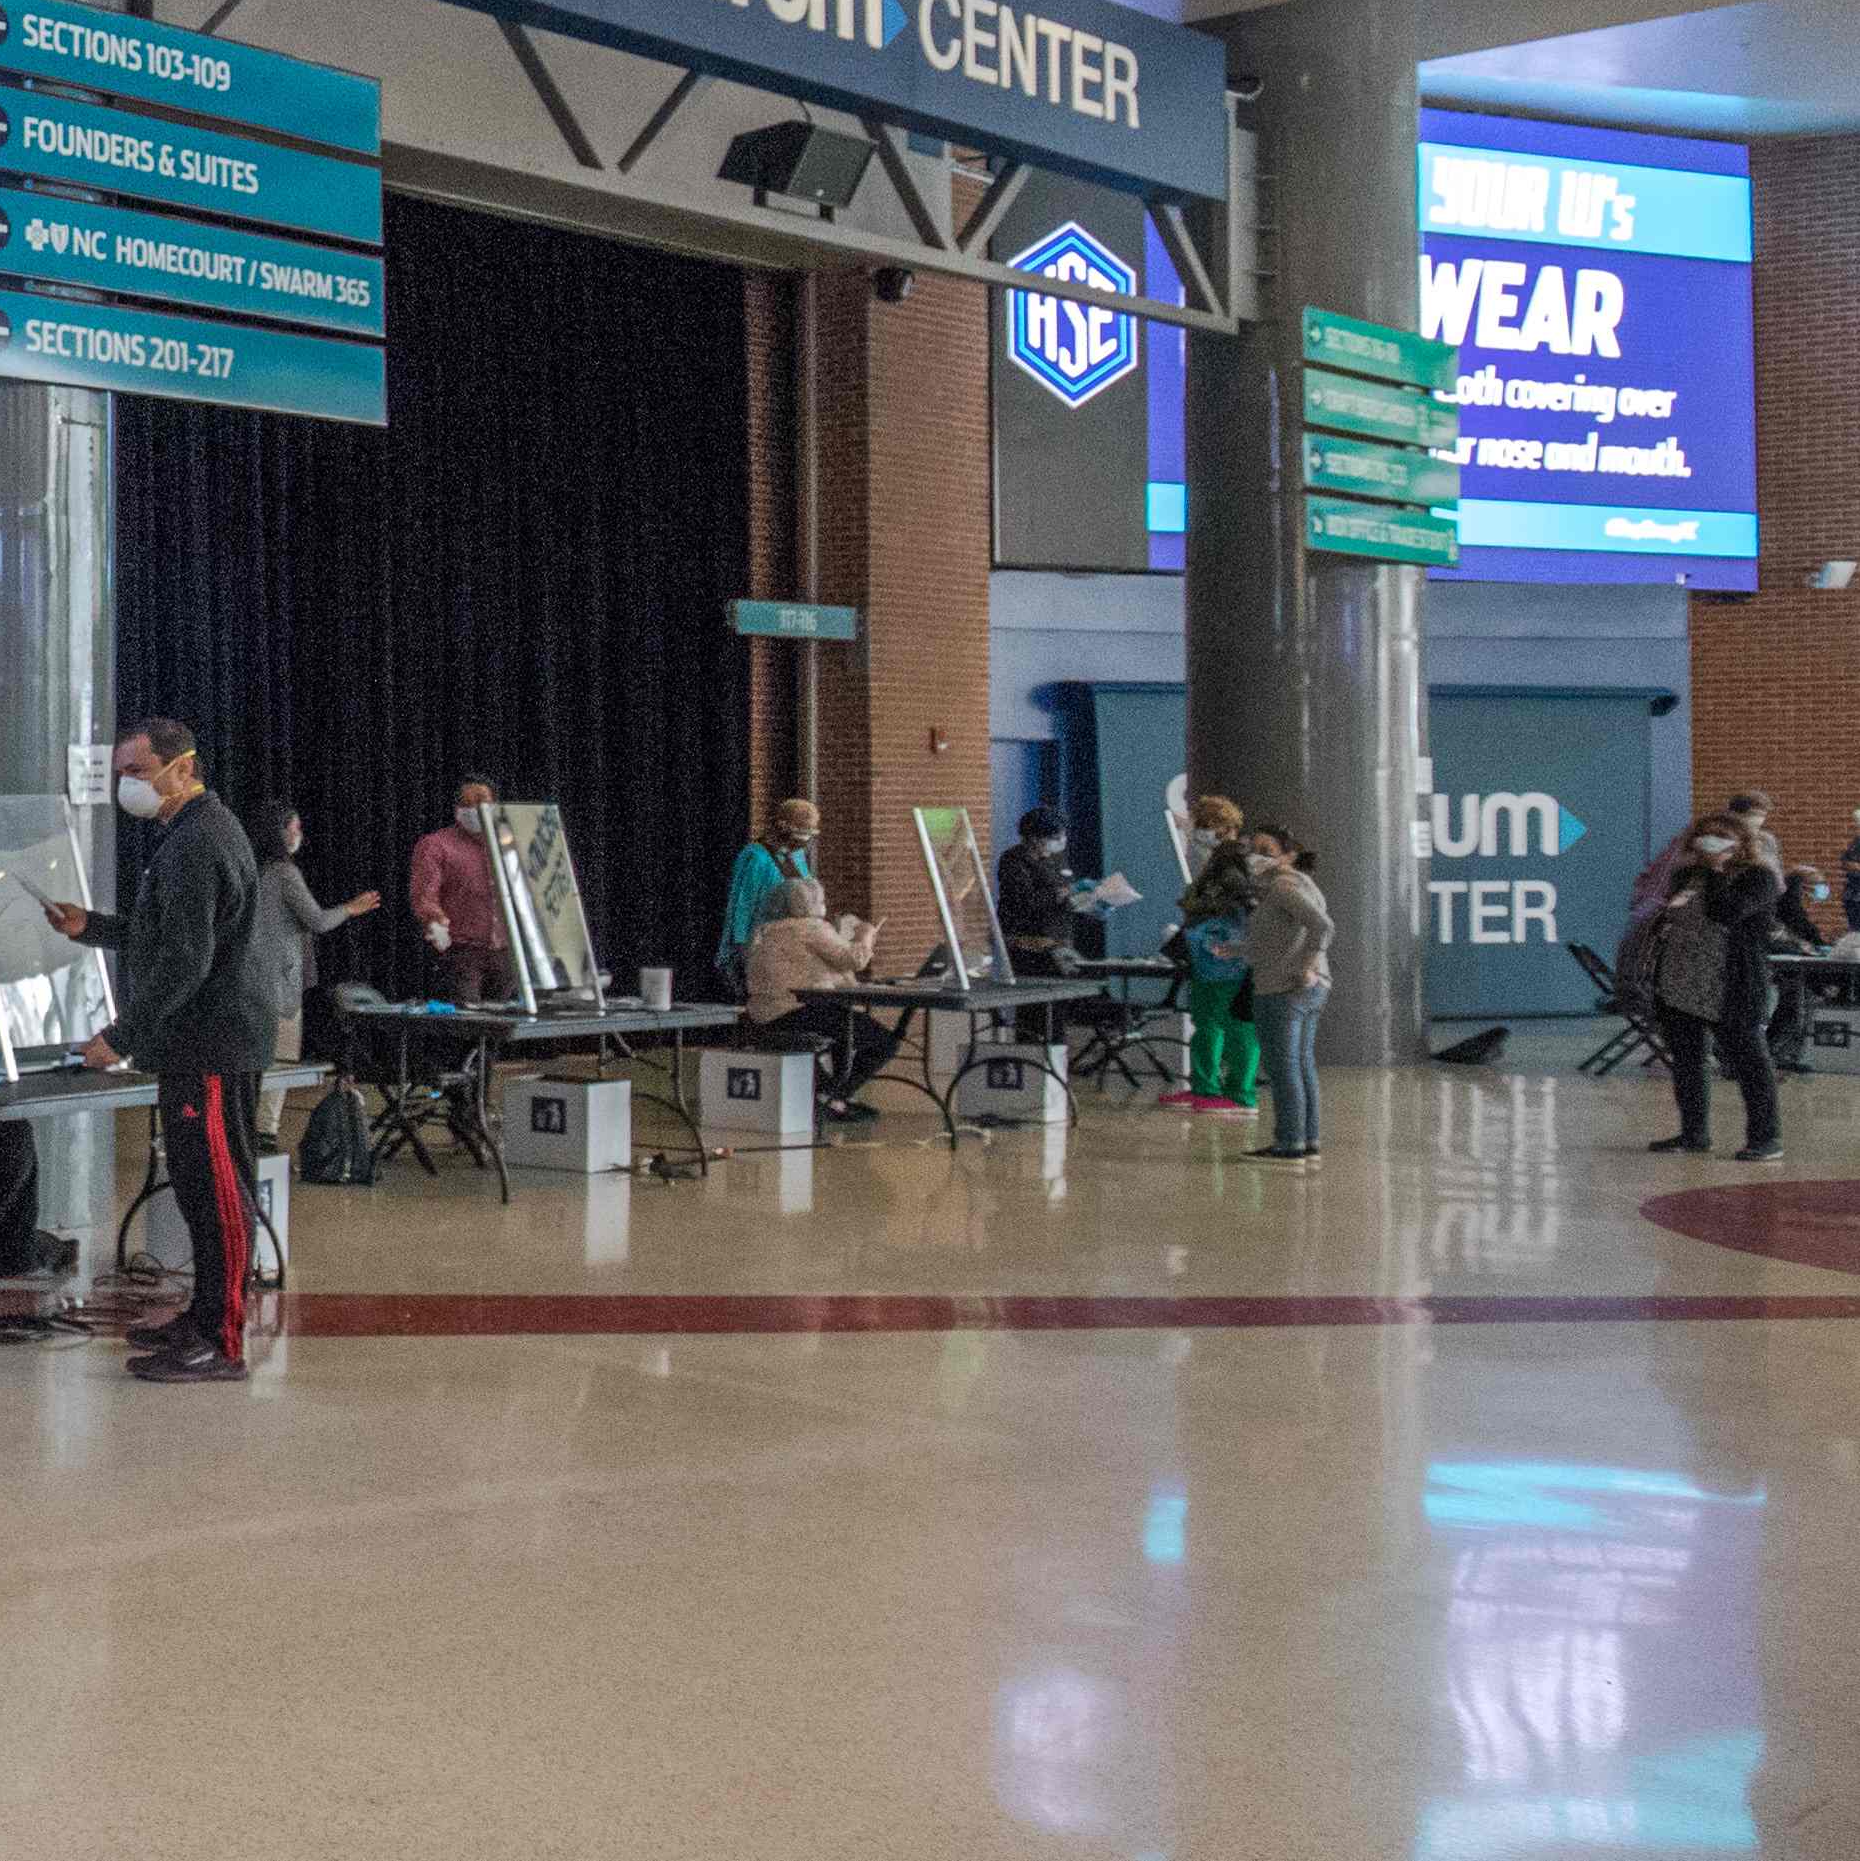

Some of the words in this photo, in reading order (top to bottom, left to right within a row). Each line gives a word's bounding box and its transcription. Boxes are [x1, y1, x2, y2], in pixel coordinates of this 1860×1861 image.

[23, 13, 142, 71] SECTIONS
[145, 42, 231, 91] 103-109
[23, 116, 155, 173] FOUNDERS
[158, 144, 176, 178] &
[180, 149, 259, 194] SUITES
[72, 226, 107, 261] NC
[115, 235, 246, 284] HOMECOURT
[259, 261, 333, 300] SWARM
[334, 275, 371, 308] 365
[1419, 253, 1624, 359] WEAR
[25, 318, 146, 366] SECTIONS
[149, 336, 234, 379] 201-217
[1027, 251, 1118, 379] HSE
